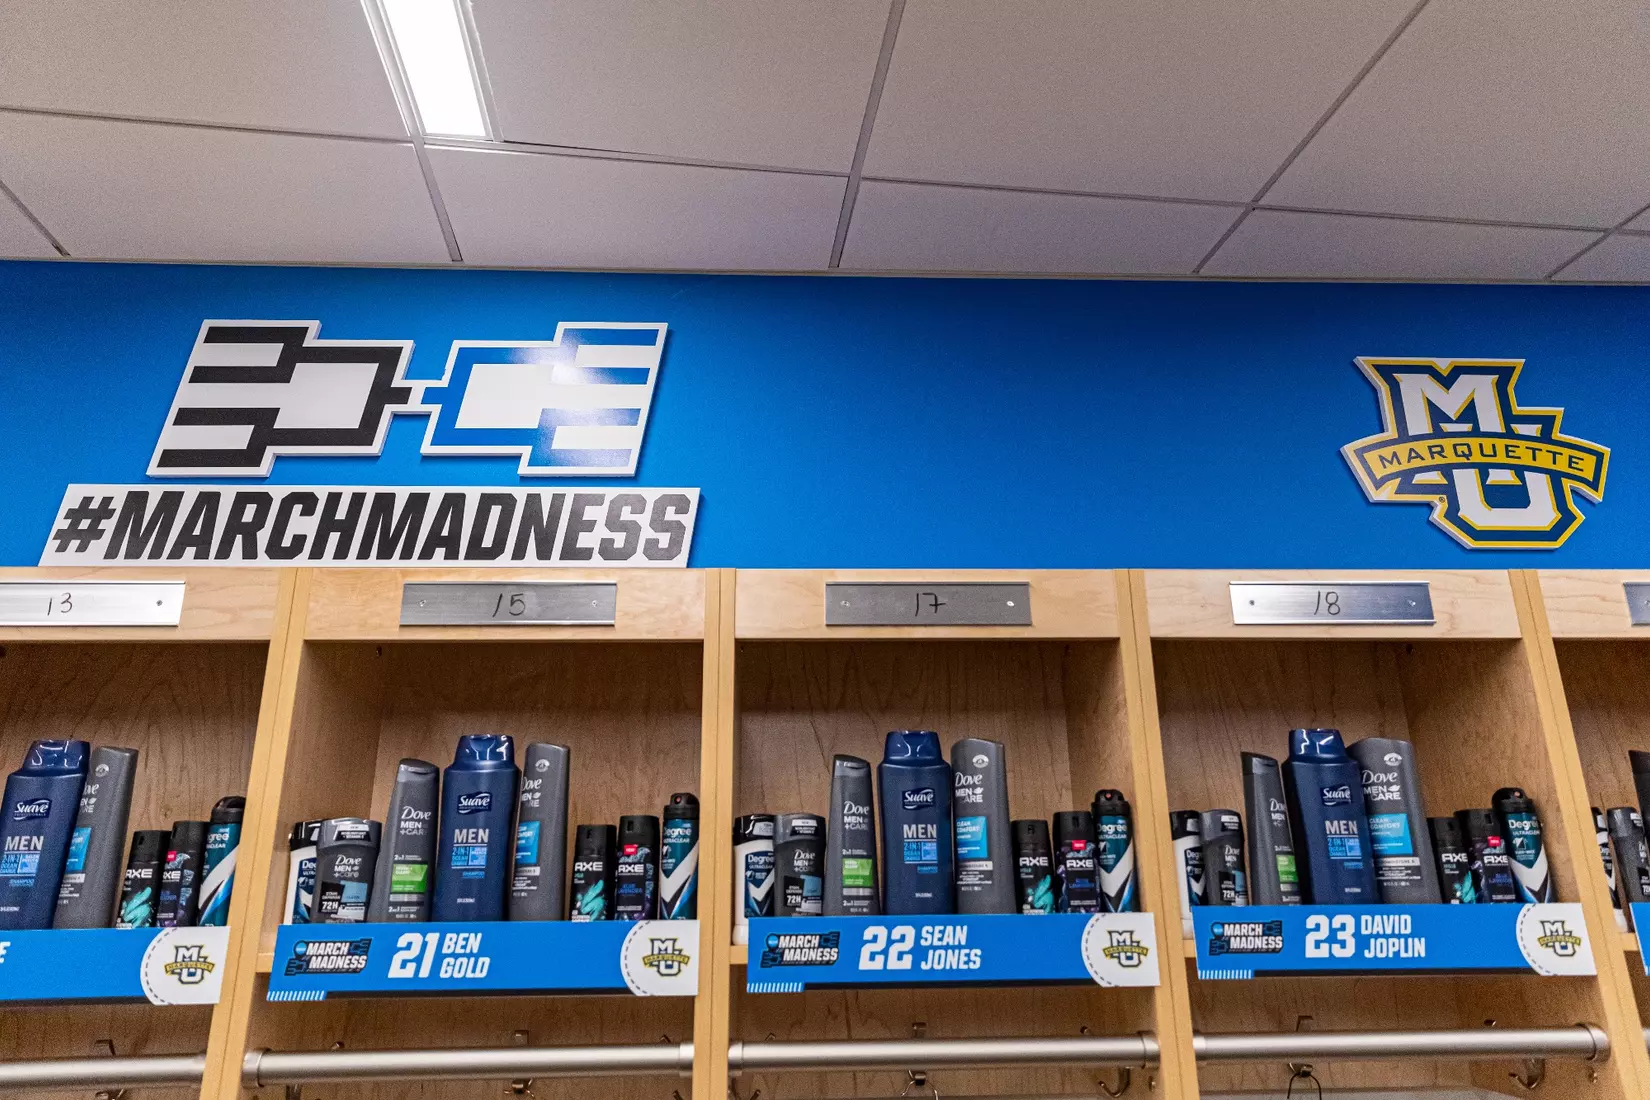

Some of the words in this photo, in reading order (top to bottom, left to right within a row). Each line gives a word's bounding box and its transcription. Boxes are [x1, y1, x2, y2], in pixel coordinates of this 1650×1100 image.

[1378, 442, 1585, 472] MARQUETTE
[52, 488, 691, 562] #MARCHMADNESS
[47, 592, 73, 616] 13
[492, 592, 526, 617] 15
[915, 592, 946, 616] 17
[1314, 590, 1341, 615] 18
[955, 772, 983, 787] Dove
[1362, 770, 1398, 784] Dove
[904, 790, 934, 802] Suave
[955, 788, 973, 797] MEN
[1323, 787, 1351, 799] Suave
[1364, 785, 1388, 794] MEN
[1371, 792, 1401, 801] CARE
[14, 800, 49, 813] Suave
[459, 794, 490, 806] Suave
[401, 806, 431, 820] Dove
[843, 800, 869, 815] Dove
[400, 821, 422, 829] MEN
[903, 824, 937, 838] MEN
[1325, 820, 1358, 834] MEN
[207, 833, 229, 843] gree
[454, 828, 489, 843] MEN
[4, 836, 44, 851] MEN
[336, 854, 362, 865] Dove
[794, 849, 816, 860] Dove
[1019, 857, 1048, 866] AXE
[1441, 853, 1468, 862] AXE
[1483, 855, 1508, 864] AXE
[574, 861, 603, 871] AXE
[618, 864, 644, 873] AXE
[1066, 859, 1093, 868] AXE
[1223, 923, 1263, 936] MARCH
[1361, 914, 1411, 935] DAVID
[778, 935, 819, 949] MARCH
[920, 925, 968, 946] SEAN
[1229, 936, 1283, 949] MADNESS
[1305, 914, 1355, 958] 23
[305, 942, 349, 955] MARCH
[442, 932, 482, 954] BEN
[858, 925, 915, 970] 22
[1364, 937, 1426, 958] JOPLIN
[387, 932, 440, 978] 21
[783, 948, 838, 961] MADNESS
[920, 949, 981, 970] JONES
[308, 955, 367, 969] MADNESS
[439, 957, 490, 978] GOLD
